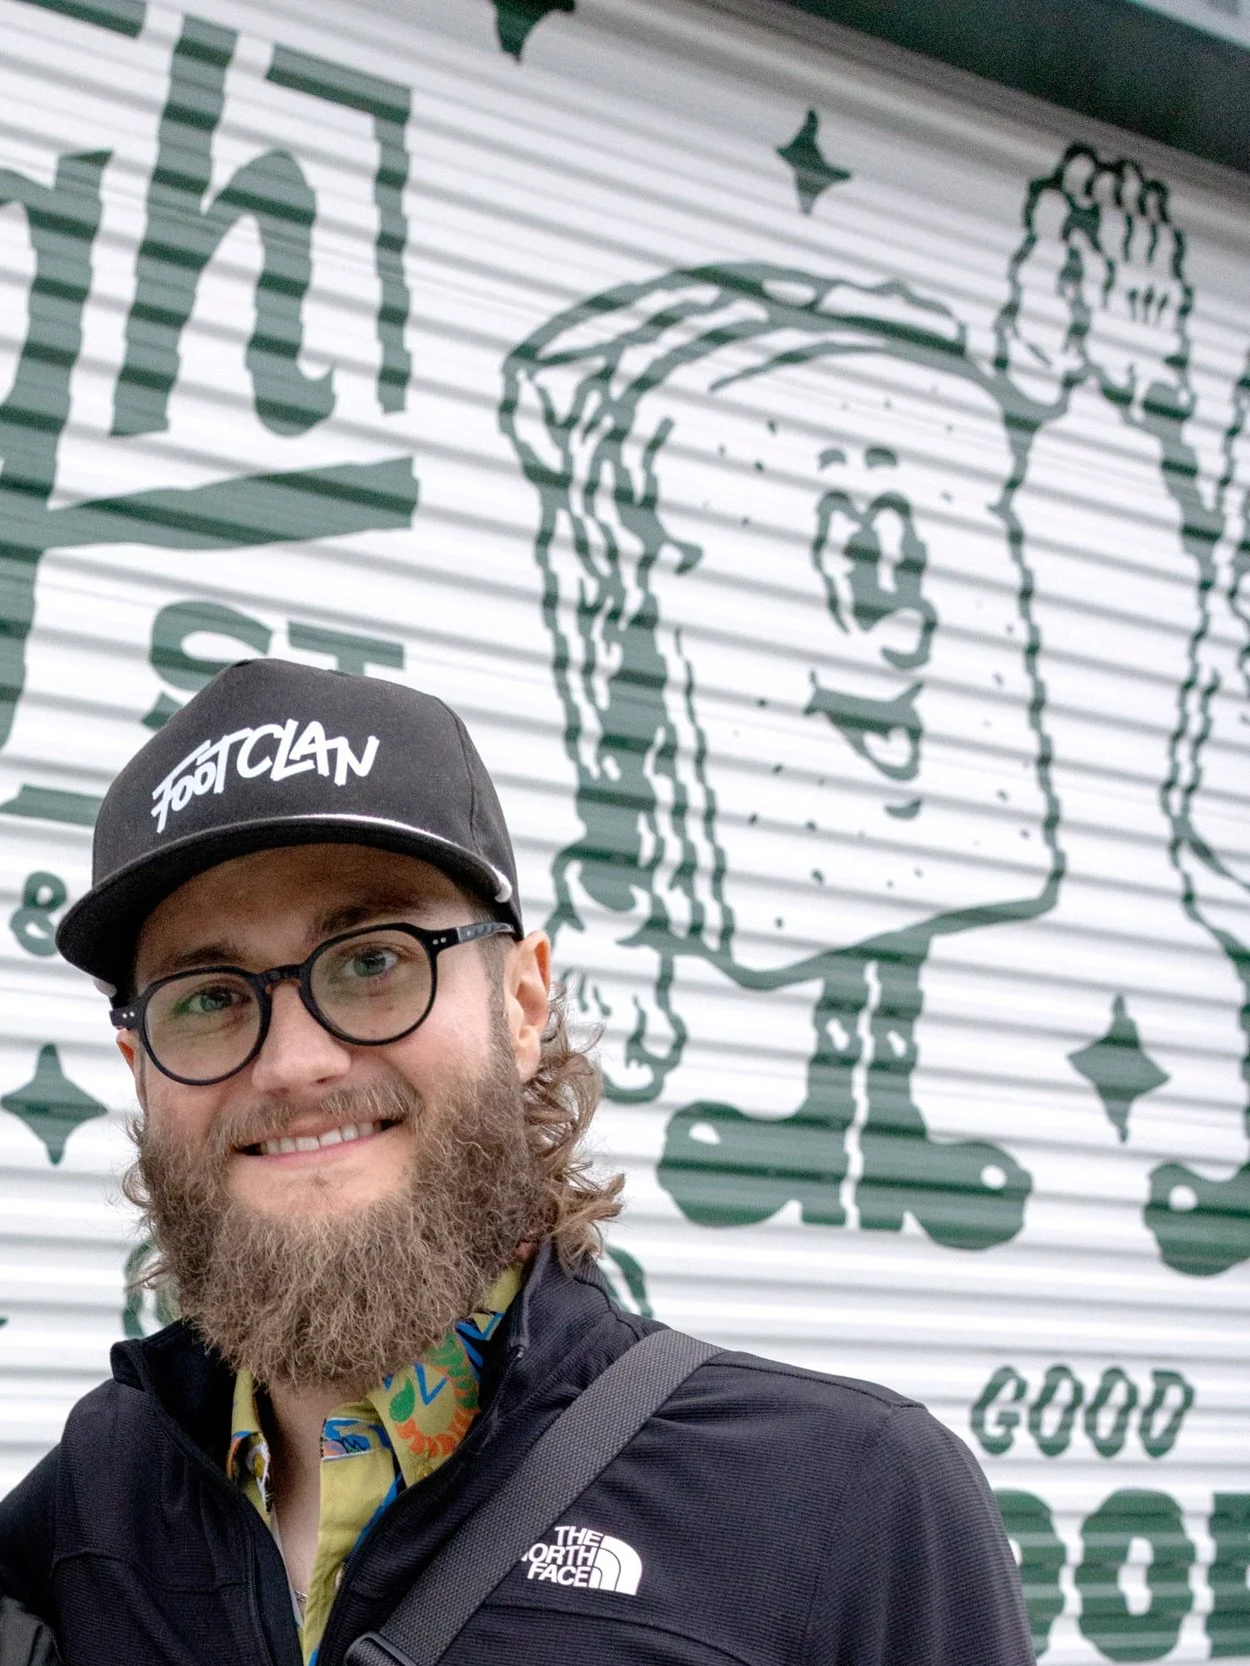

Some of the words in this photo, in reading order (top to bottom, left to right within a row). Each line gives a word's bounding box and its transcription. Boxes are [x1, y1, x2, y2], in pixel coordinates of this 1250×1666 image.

[970, 1364, 1196, 1459] GOOD
[554, 1526, 603, 1547] THE
[527, 1562, 592, 1588] FACE
